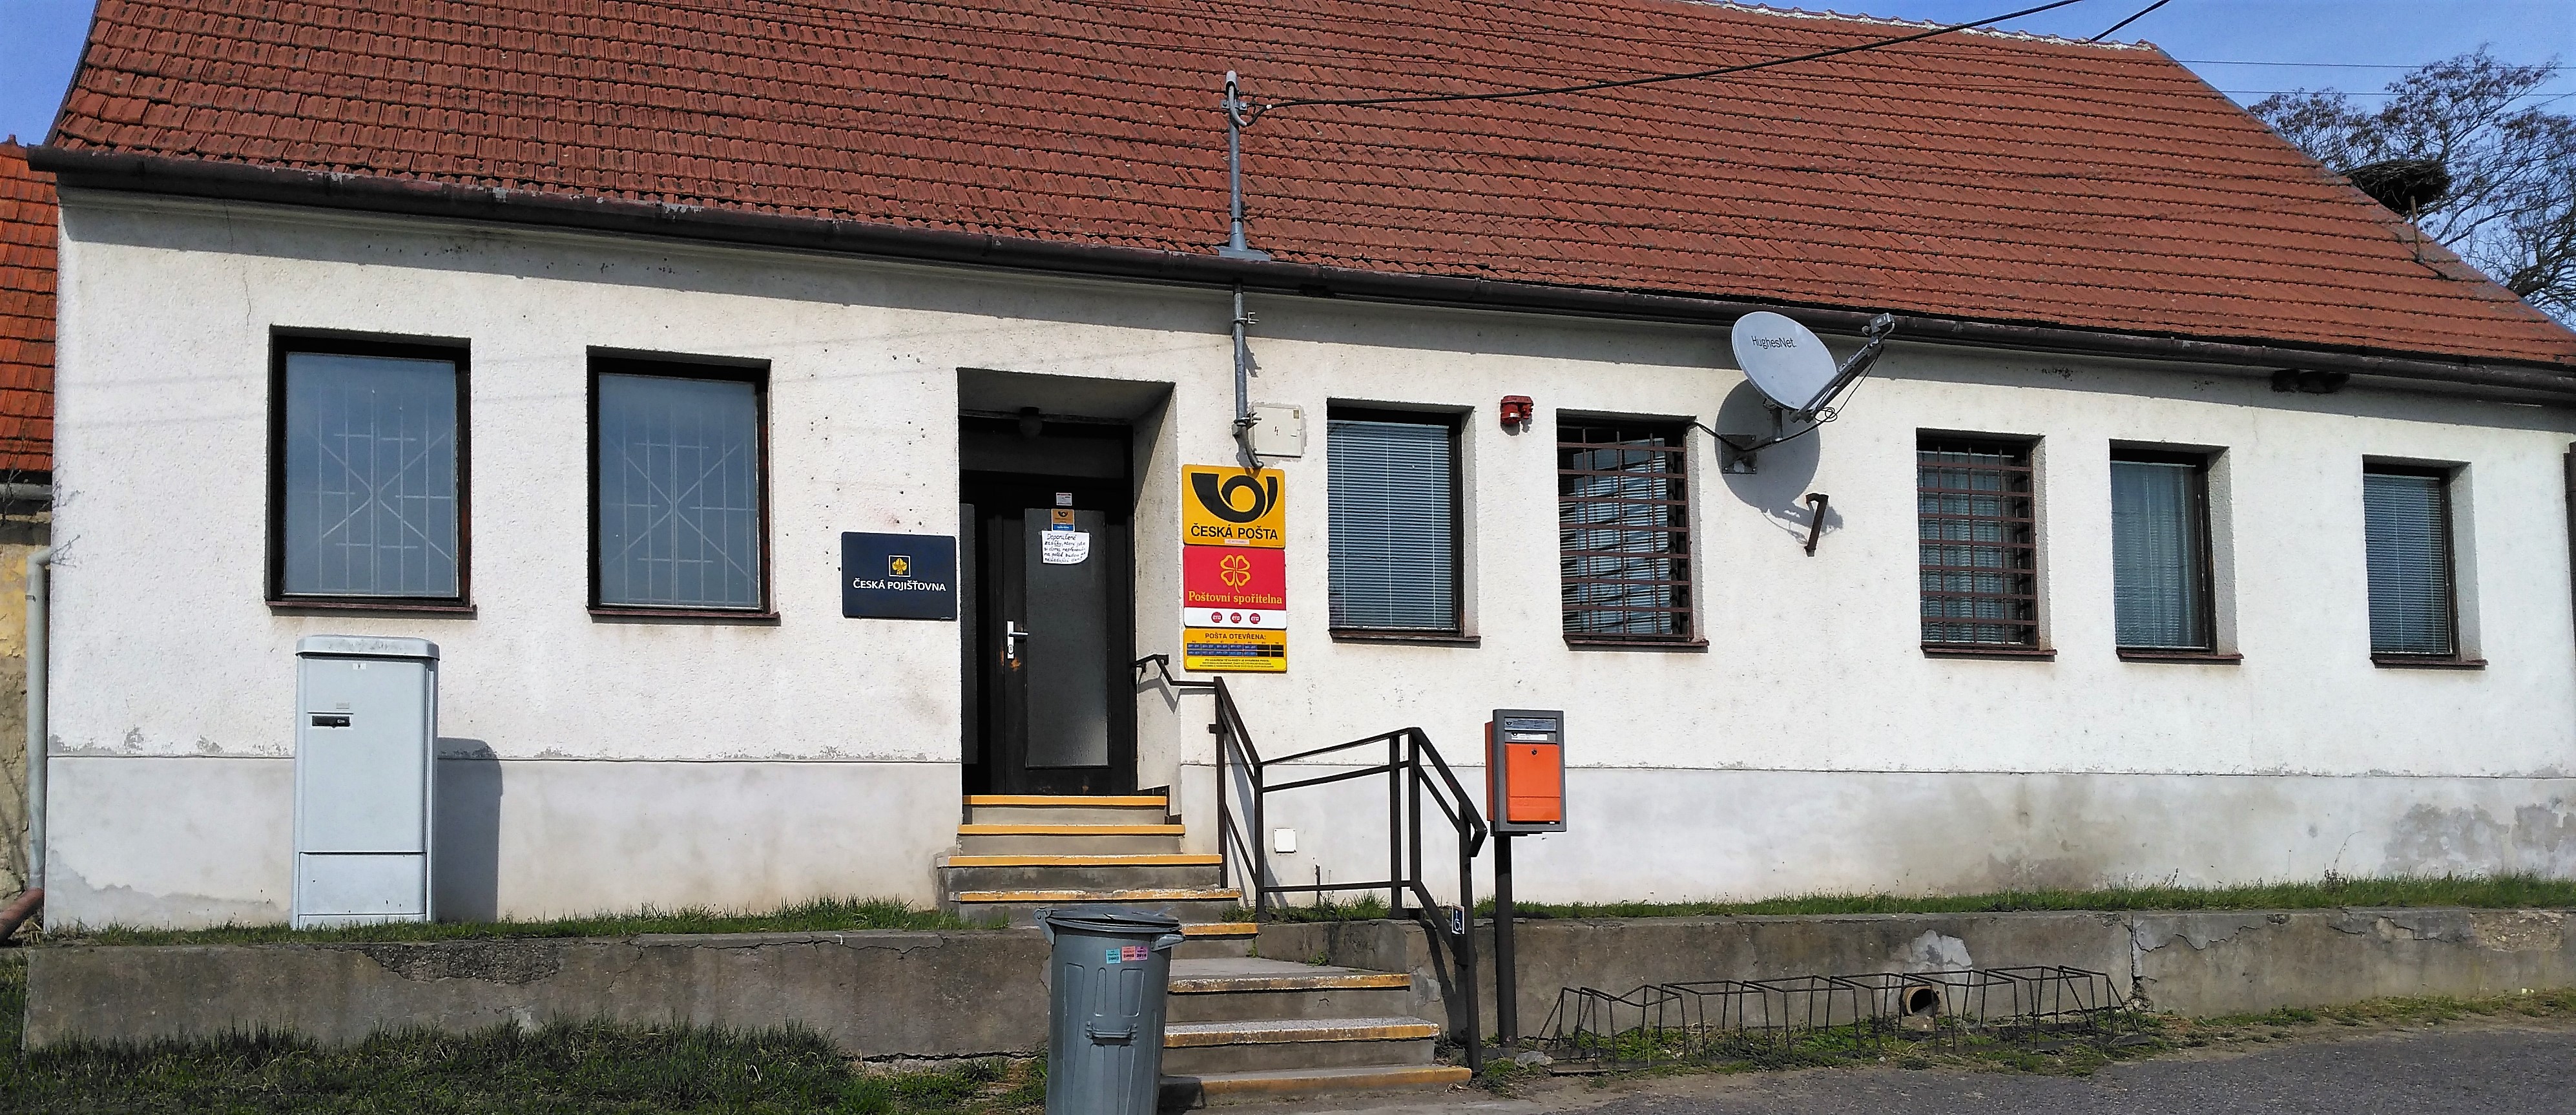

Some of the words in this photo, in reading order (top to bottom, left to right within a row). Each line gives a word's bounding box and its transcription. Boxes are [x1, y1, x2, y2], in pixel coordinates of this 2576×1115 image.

[1190, 523, 1233, 538] ČESKÁ
[1238, 525, 1278, 540] POŠTA
[853, 578, 886, 590] ČESKÁ
[888, 580, 946, 592] POJIŠŤOVNA
[1189, 591, 1231, 602] Poštovní
[1233, 593, 1283, 605] spořitelna
